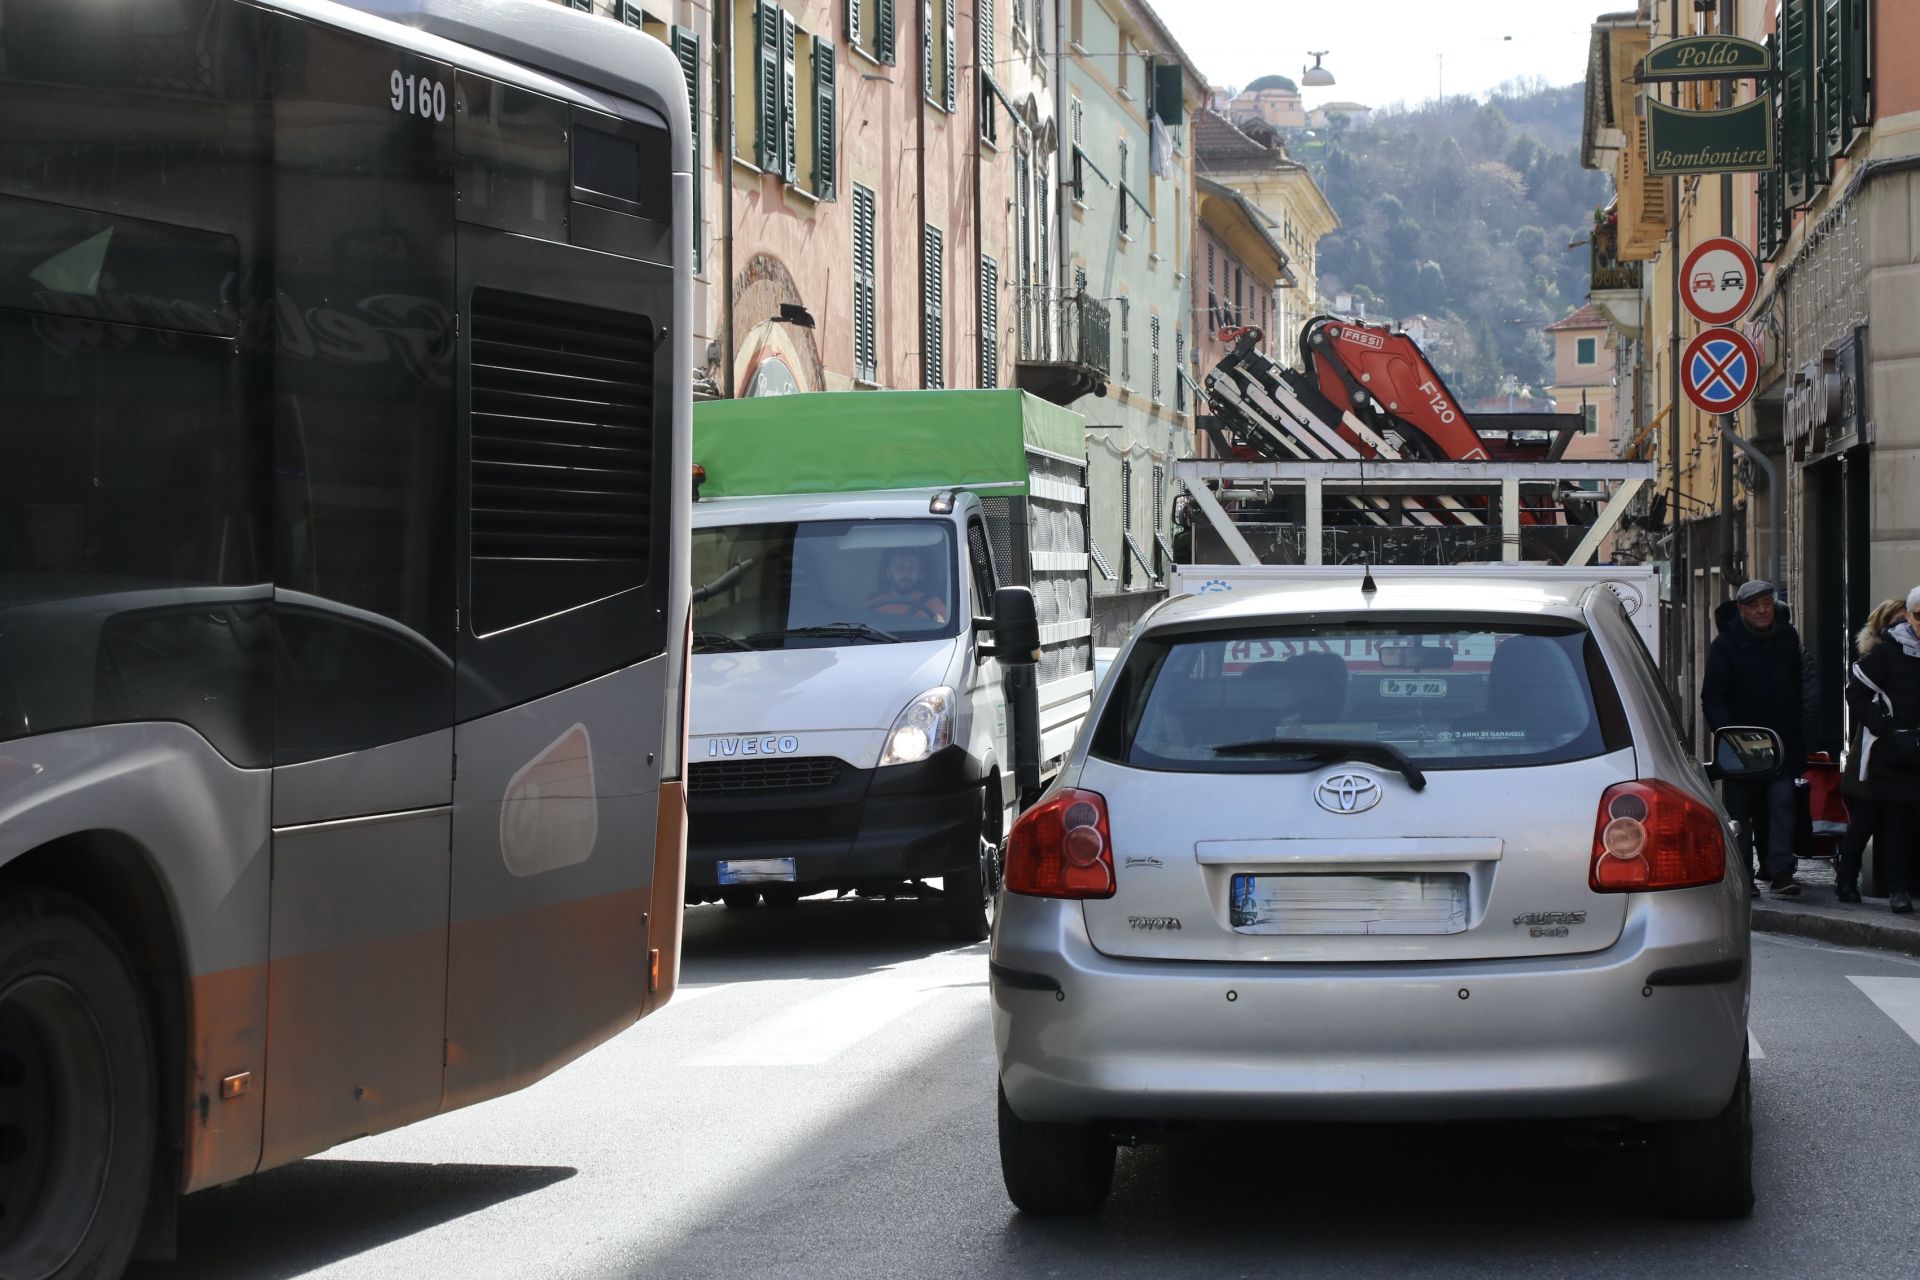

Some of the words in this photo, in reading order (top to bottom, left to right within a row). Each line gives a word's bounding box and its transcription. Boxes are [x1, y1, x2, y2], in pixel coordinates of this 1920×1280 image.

[1676, 41, 1739, 67] Poldo
[390, 68, 446, 122] 9160
[1656, 146, 1766, 168] Bomboniere
[1344, 331, 1381, 346] FASSI
[1419, 381, 1455, 424] F120
[708, 735, 799, 757] IVECO
[1129, 917, 1181, 930] TOYOTA
[1513, 911, 1587, 925] AURIS
